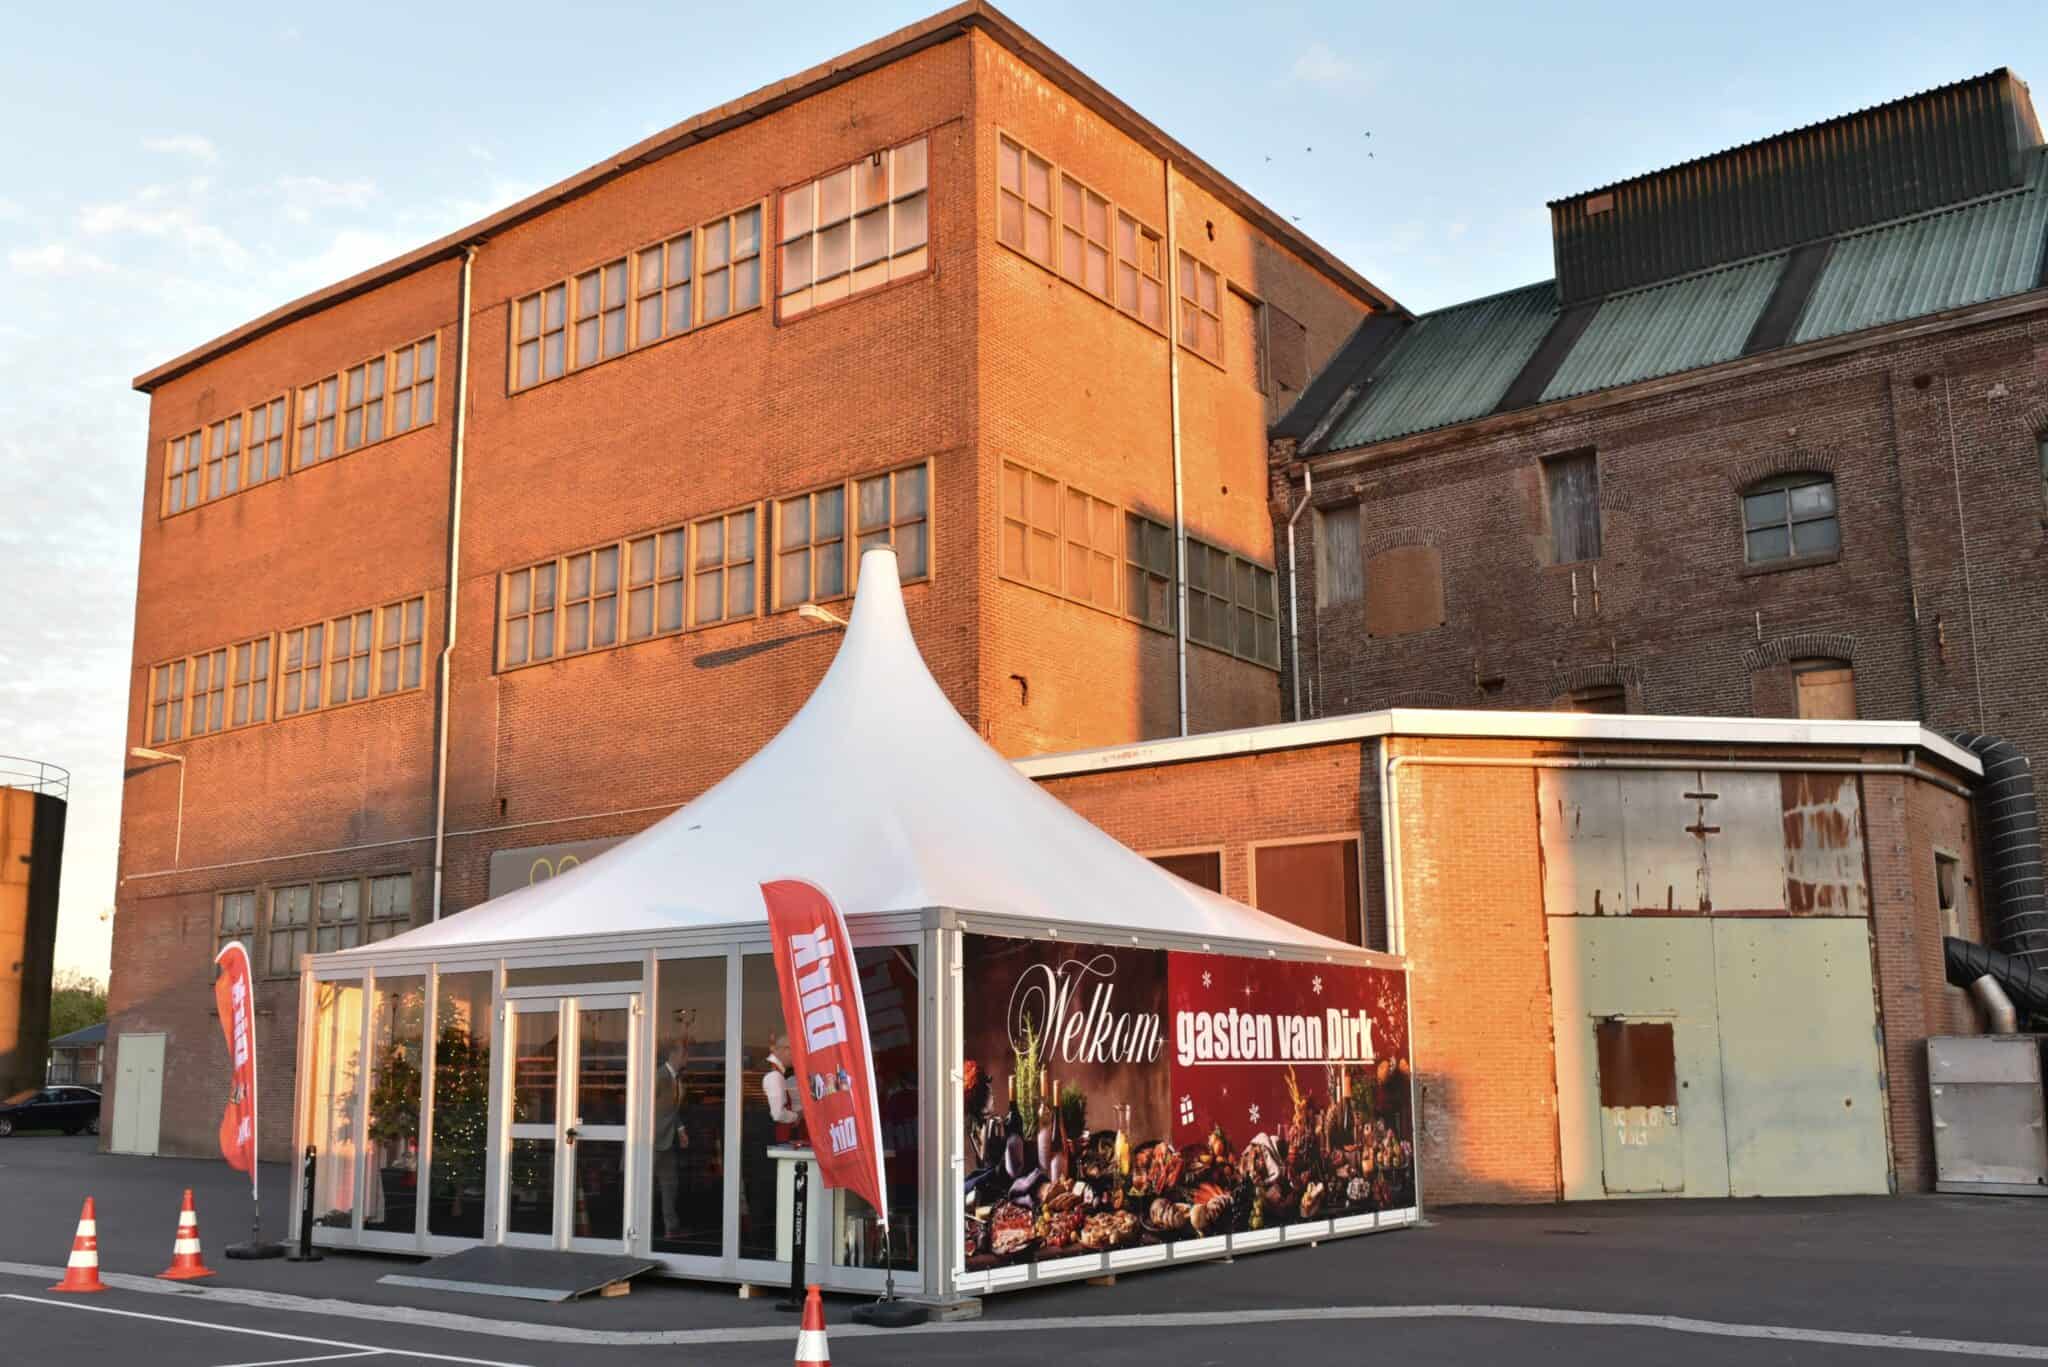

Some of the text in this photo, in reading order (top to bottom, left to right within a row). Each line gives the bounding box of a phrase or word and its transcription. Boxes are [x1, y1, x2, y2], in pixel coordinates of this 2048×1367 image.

[1007, 954, 1375, 1066] Welkom gasten van Dirk
